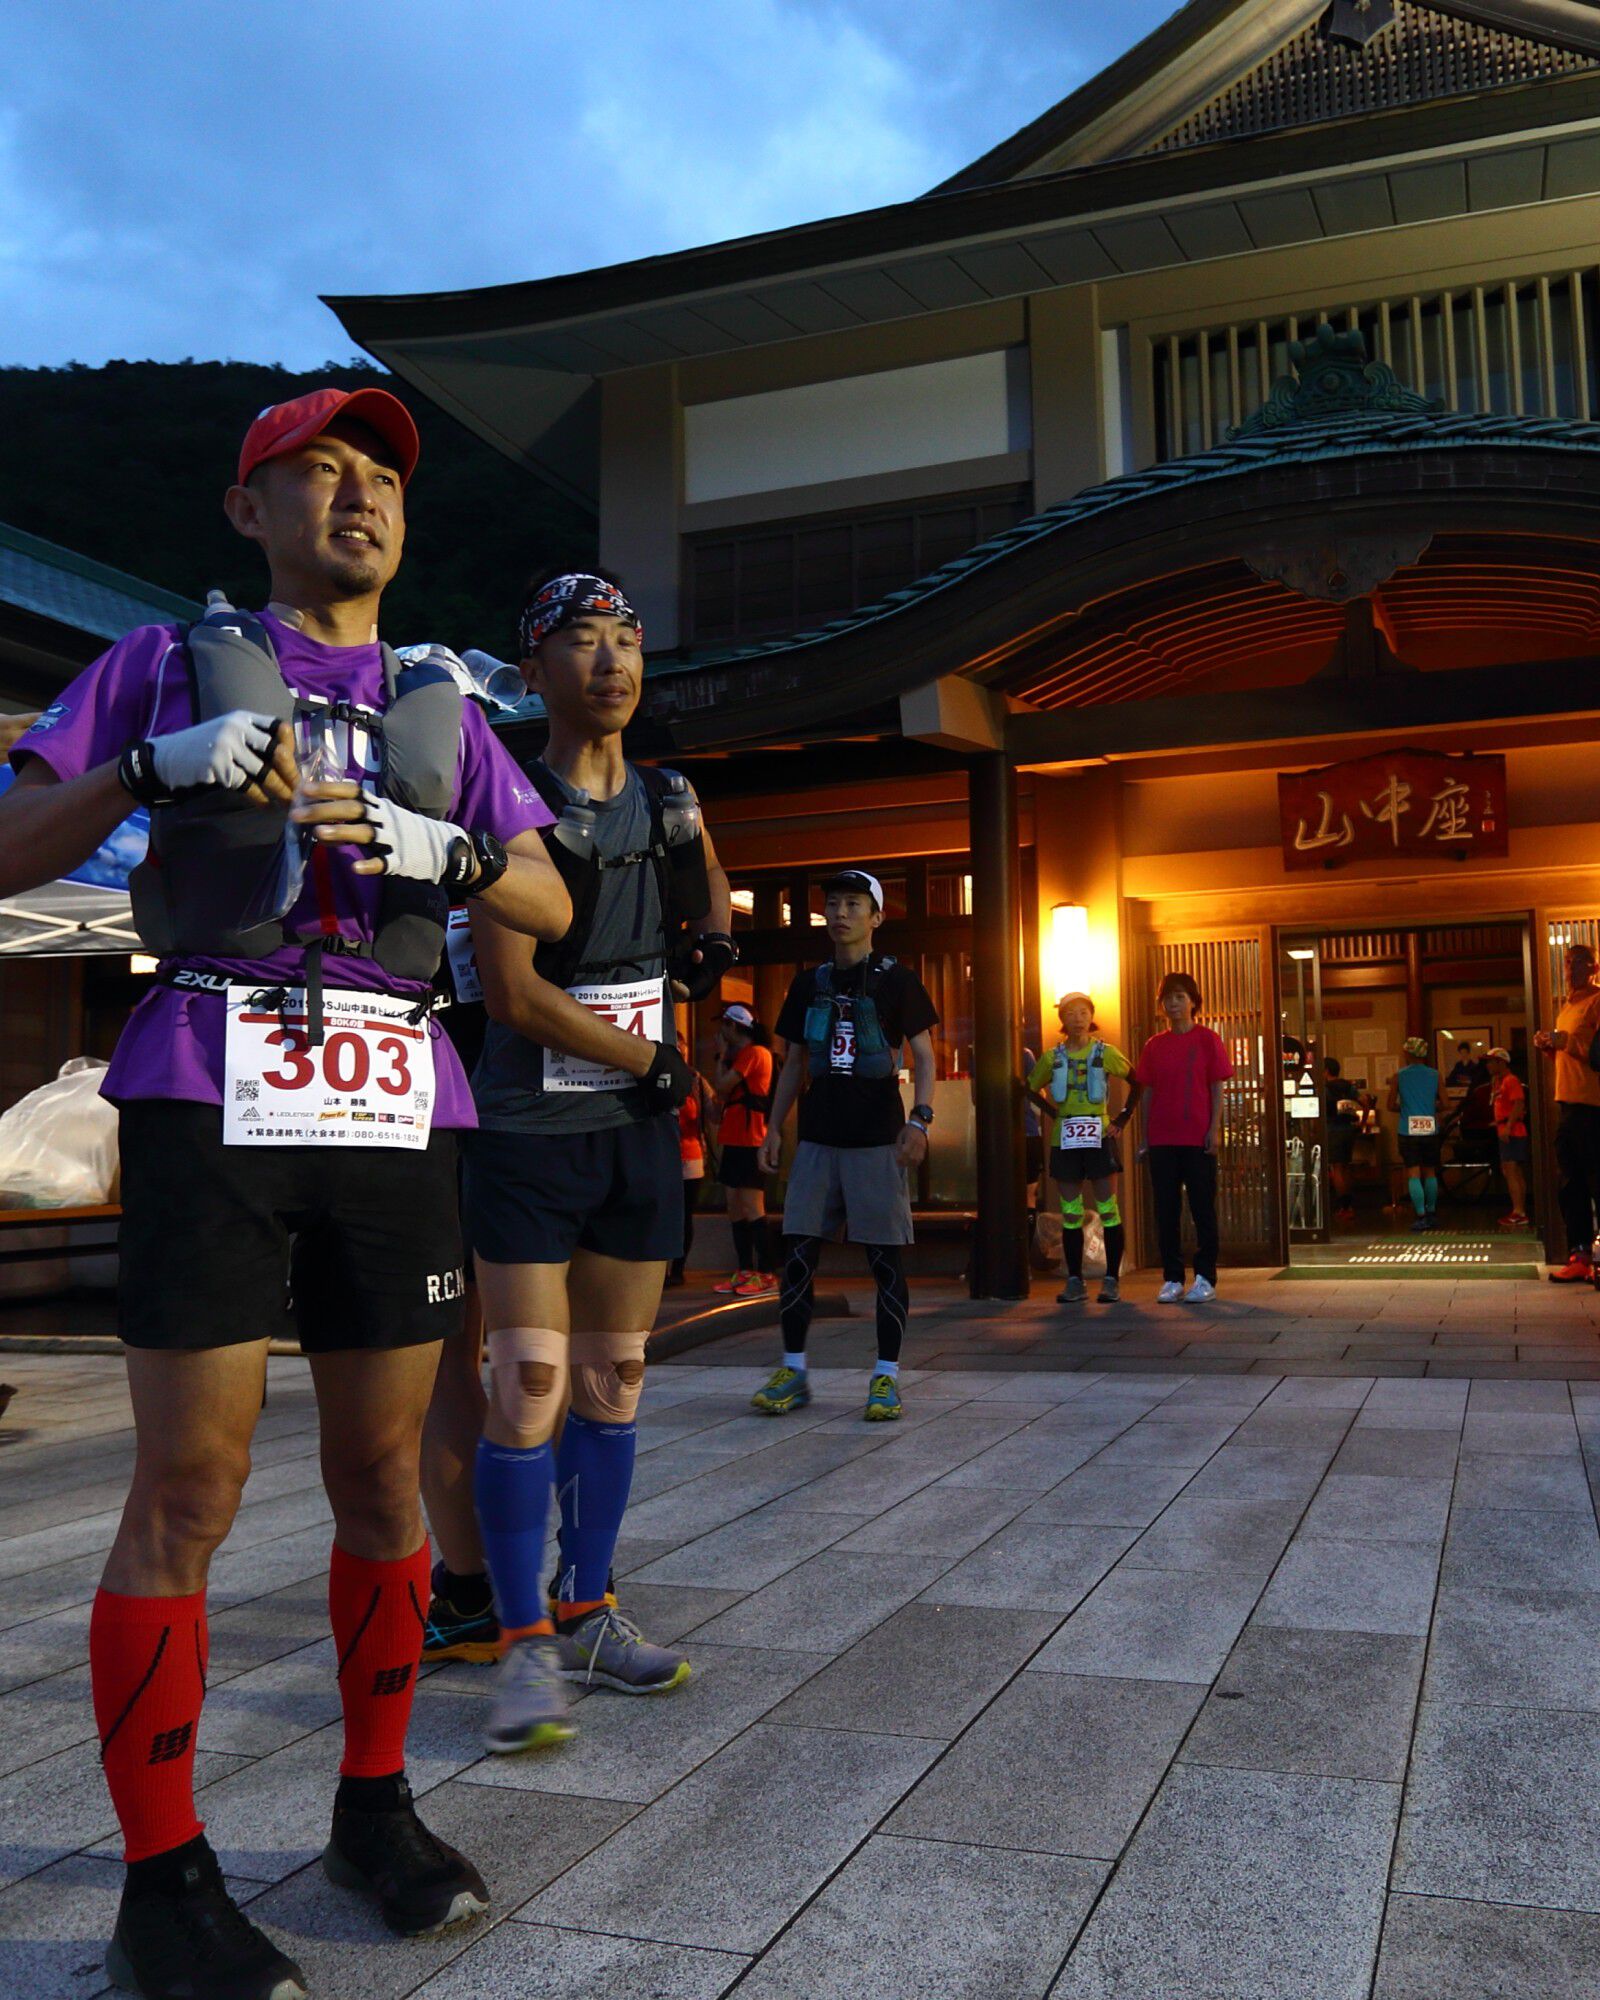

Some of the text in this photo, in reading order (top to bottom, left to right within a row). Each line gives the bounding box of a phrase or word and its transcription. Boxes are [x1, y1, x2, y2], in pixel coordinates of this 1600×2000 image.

[1295, 774, 1473, 850] 山中座
[173, 970, 233, 991] 2XU
[578, 992, 599, 1000] 2019
[262, 1028, 412, 1096] 303
[323, 1098, 341, 1106] 山本
[1066, 1124, 1097, 1138] 322
